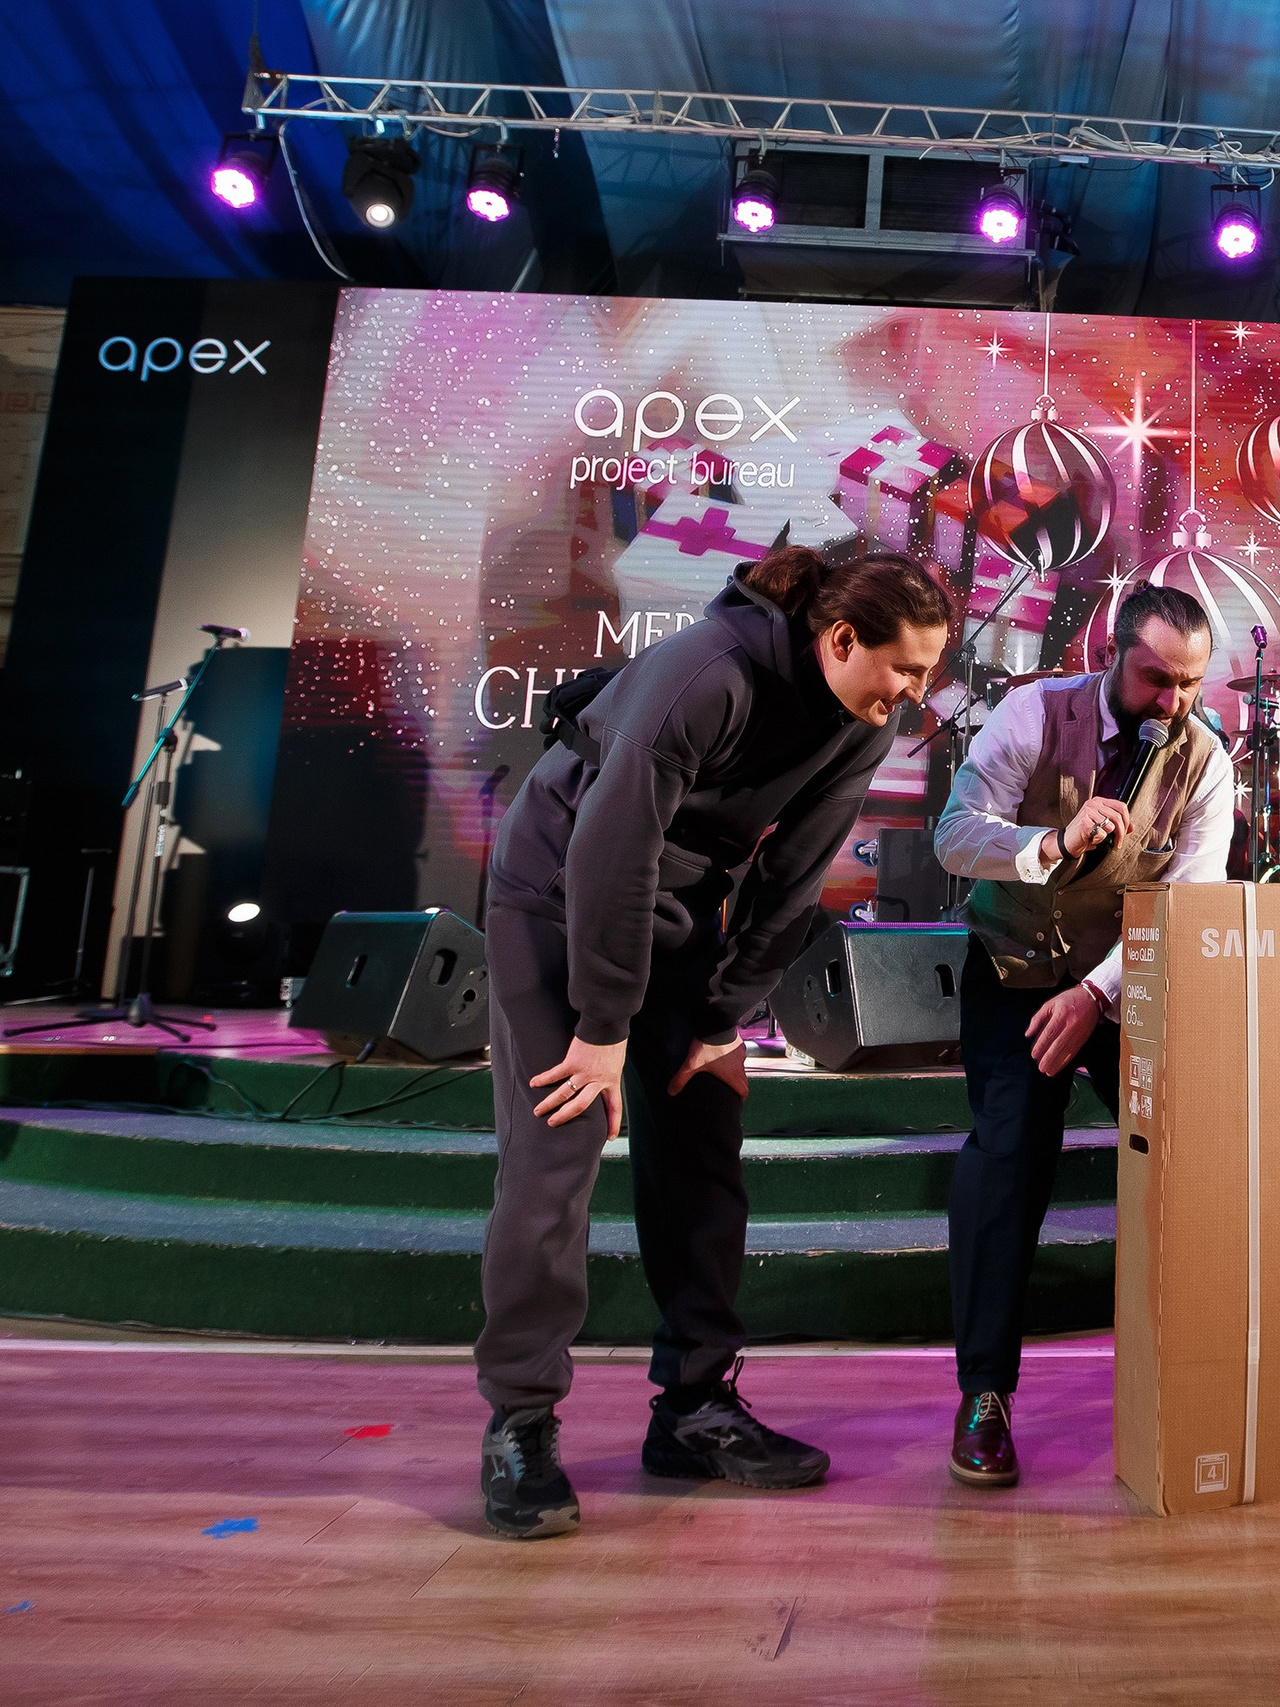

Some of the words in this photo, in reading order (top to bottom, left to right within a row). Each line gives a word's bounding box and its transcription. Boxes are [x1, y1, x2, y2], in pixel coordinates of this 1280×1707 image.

[98, 336, 271, 382] apex
[574, 388, 800, 452] apex
[570, 452, 677, 490] project
[691, 452, 795, 488] bureau
[1128, 927, 1160, 941] SAMSUNG
[1127, 947, 1139, 961] Neo
[1139, 948, 1155, 962] QLED
[1126, 1004, 1137, 1025] 65
[1207, 1465, 1217, 1480] 4
